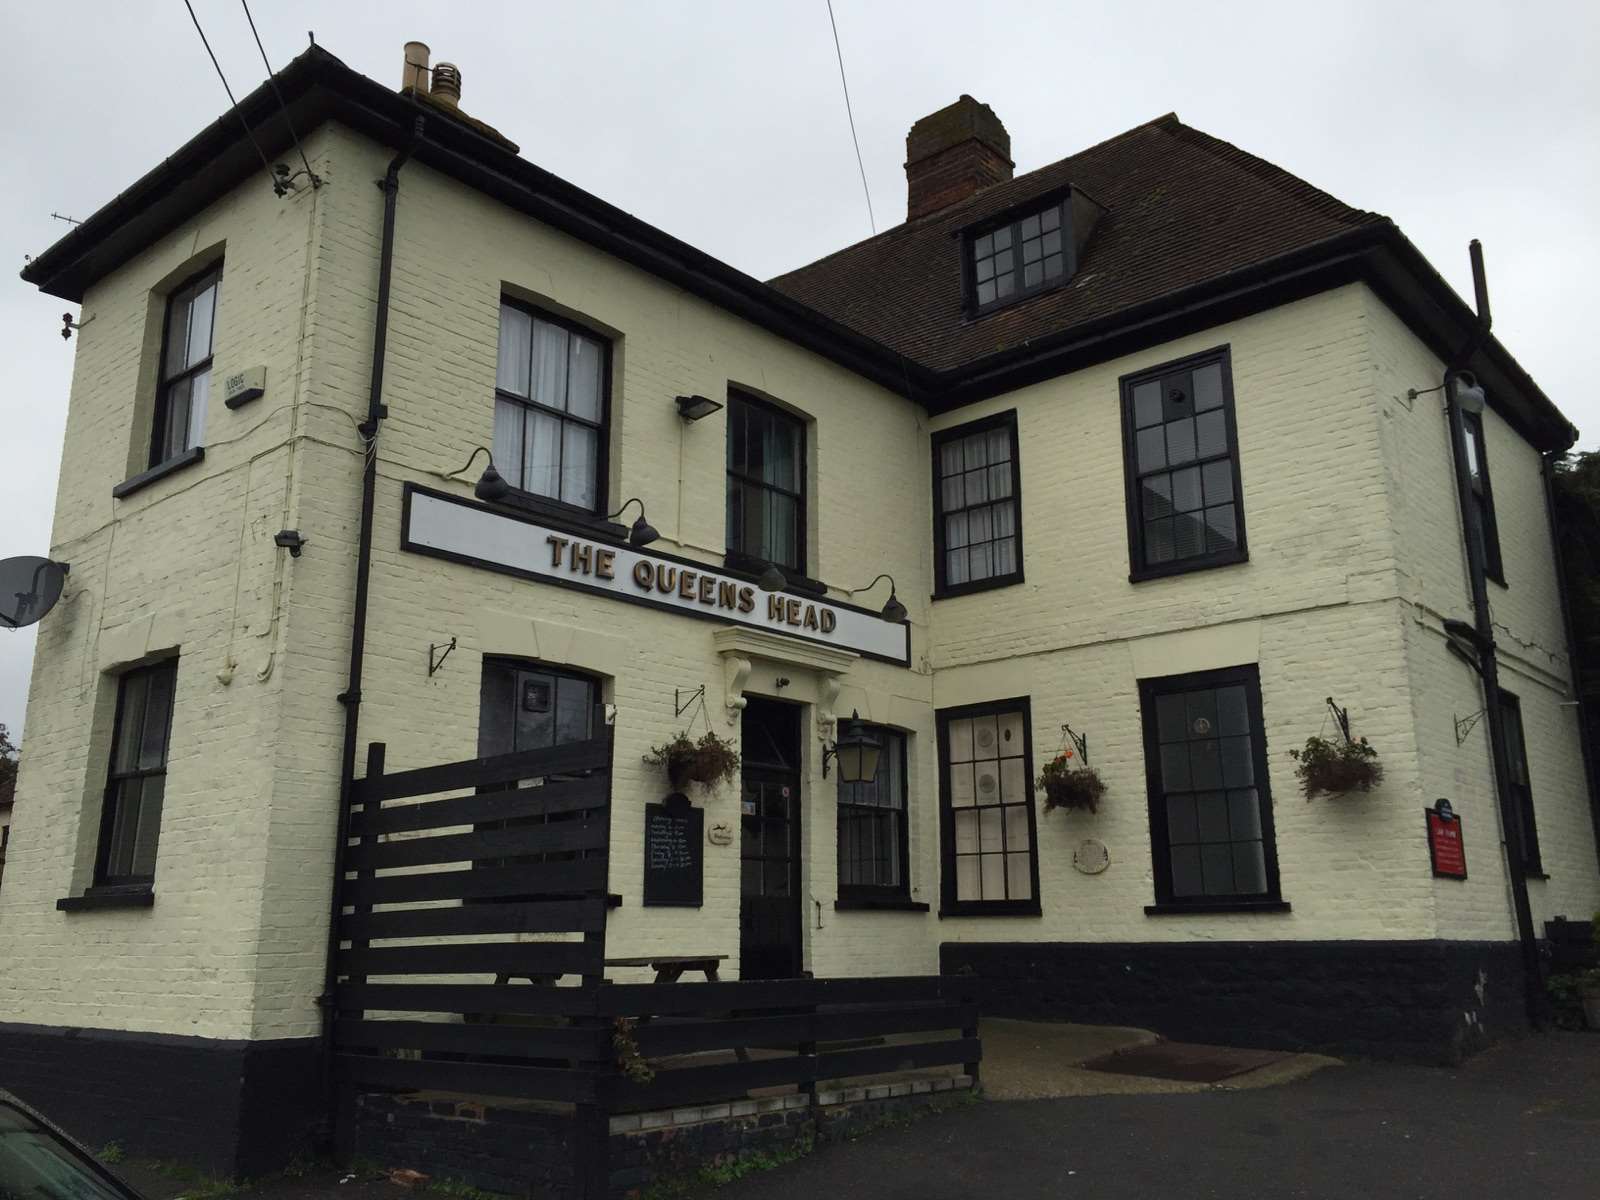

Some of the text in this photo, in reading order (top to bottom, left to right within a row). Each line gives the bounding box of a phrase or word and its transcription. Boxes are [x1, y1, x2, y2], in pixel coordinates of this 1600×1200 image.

[547, 535, 837, 634] THE QUEENS HEAD
